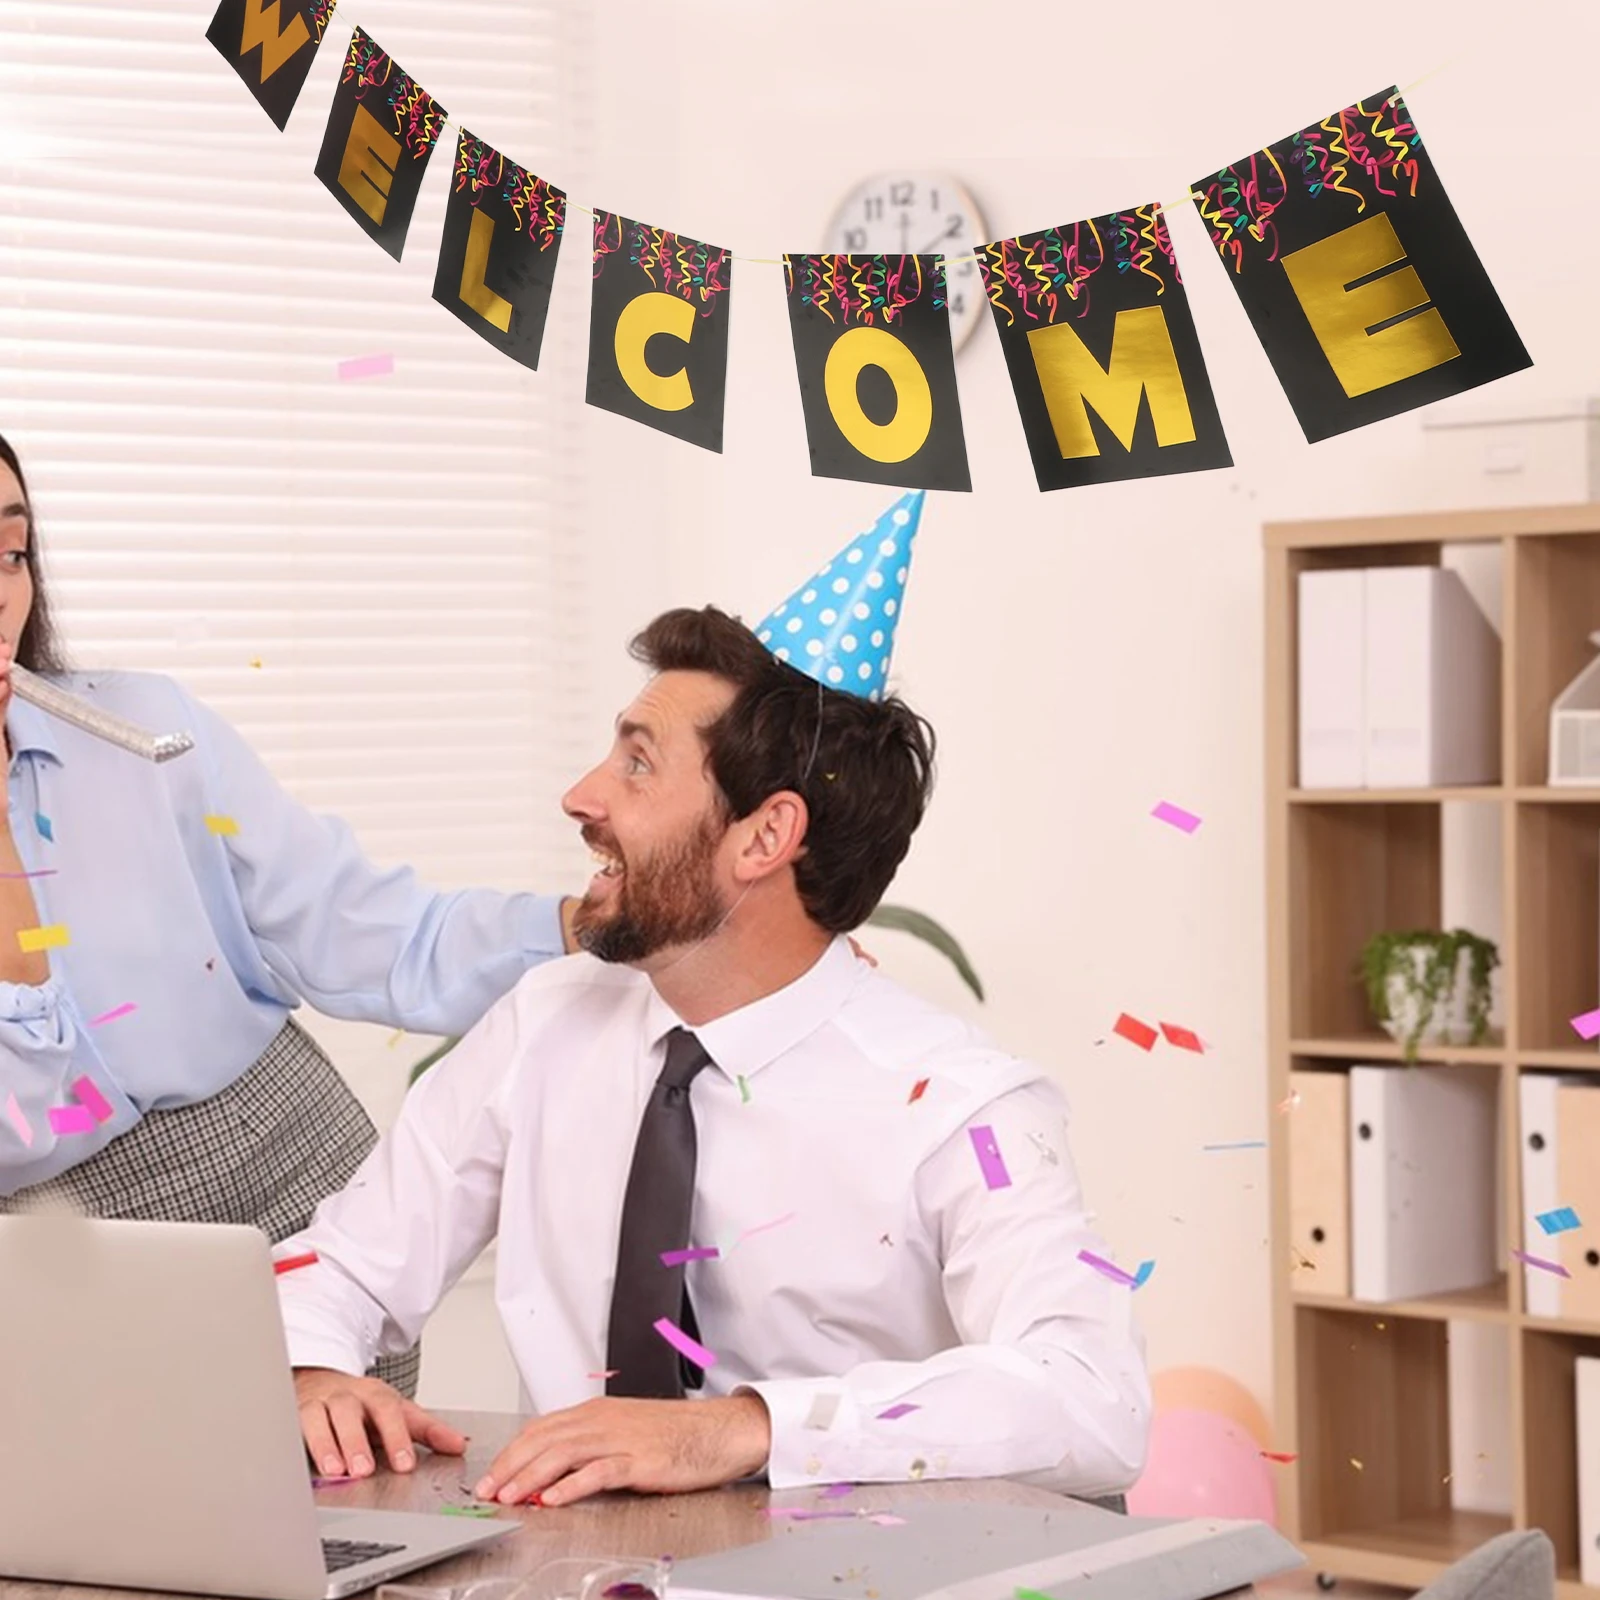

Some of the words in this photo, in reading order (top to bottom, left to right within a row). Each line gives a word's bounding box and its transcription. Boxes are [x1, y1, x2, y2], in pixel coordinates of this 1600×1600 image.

[889, 180, 915, 207] 12
[930, 188, 939, 213] 1
[864, 196, 884, 223] 11
[945, 214, 964, 239] 2
[843, 227, 867, 252] 10
